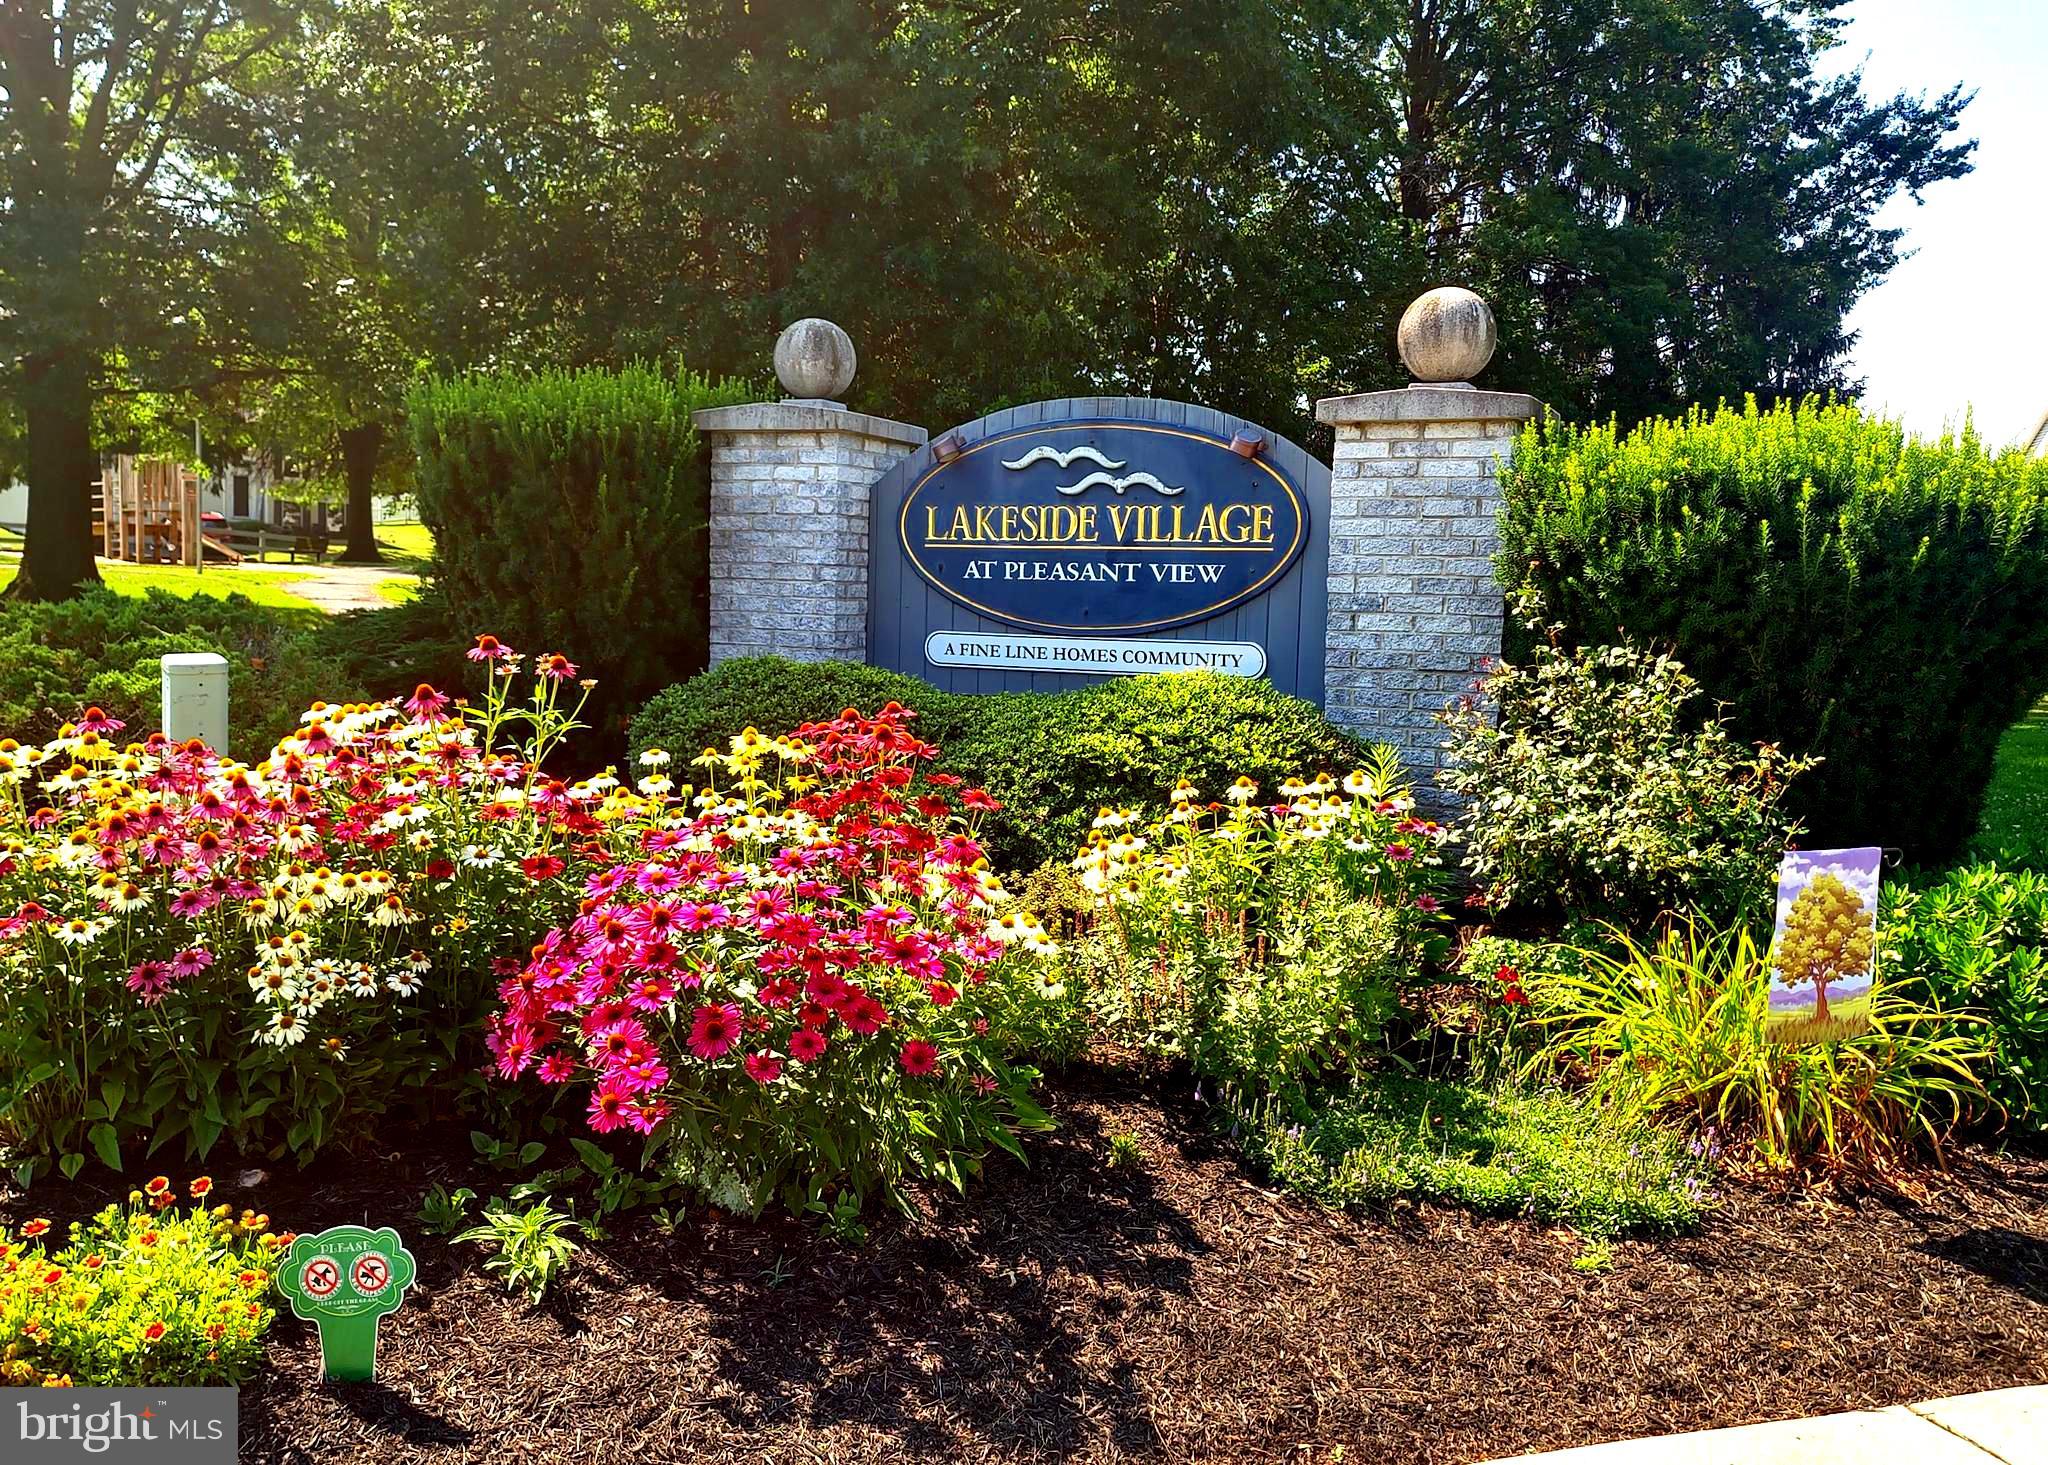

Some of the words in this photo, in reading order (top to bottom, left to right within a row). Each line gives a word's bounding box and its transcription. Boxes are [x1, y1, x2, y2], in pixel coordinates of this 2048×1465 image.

[925, 504, 1099, 542] LAKESIDE
[1106, 503, 1274, 543] VILLAGE
[963, 560, 997, 579] AT
[1003, 561, 1141, 582] PLEASANT
[1149, 563, 1226, 583] VIEW
[944, 642, 955, 655] A
[959, 643, 1000, 658] FINE
[1005, 645, 1048, 660] LINE
[1052, 647, 1118, 664] HOMES
[1122, 650, 1243, 668] COMMUNITY
[320, 1241, 371, 1254] PLEASE
